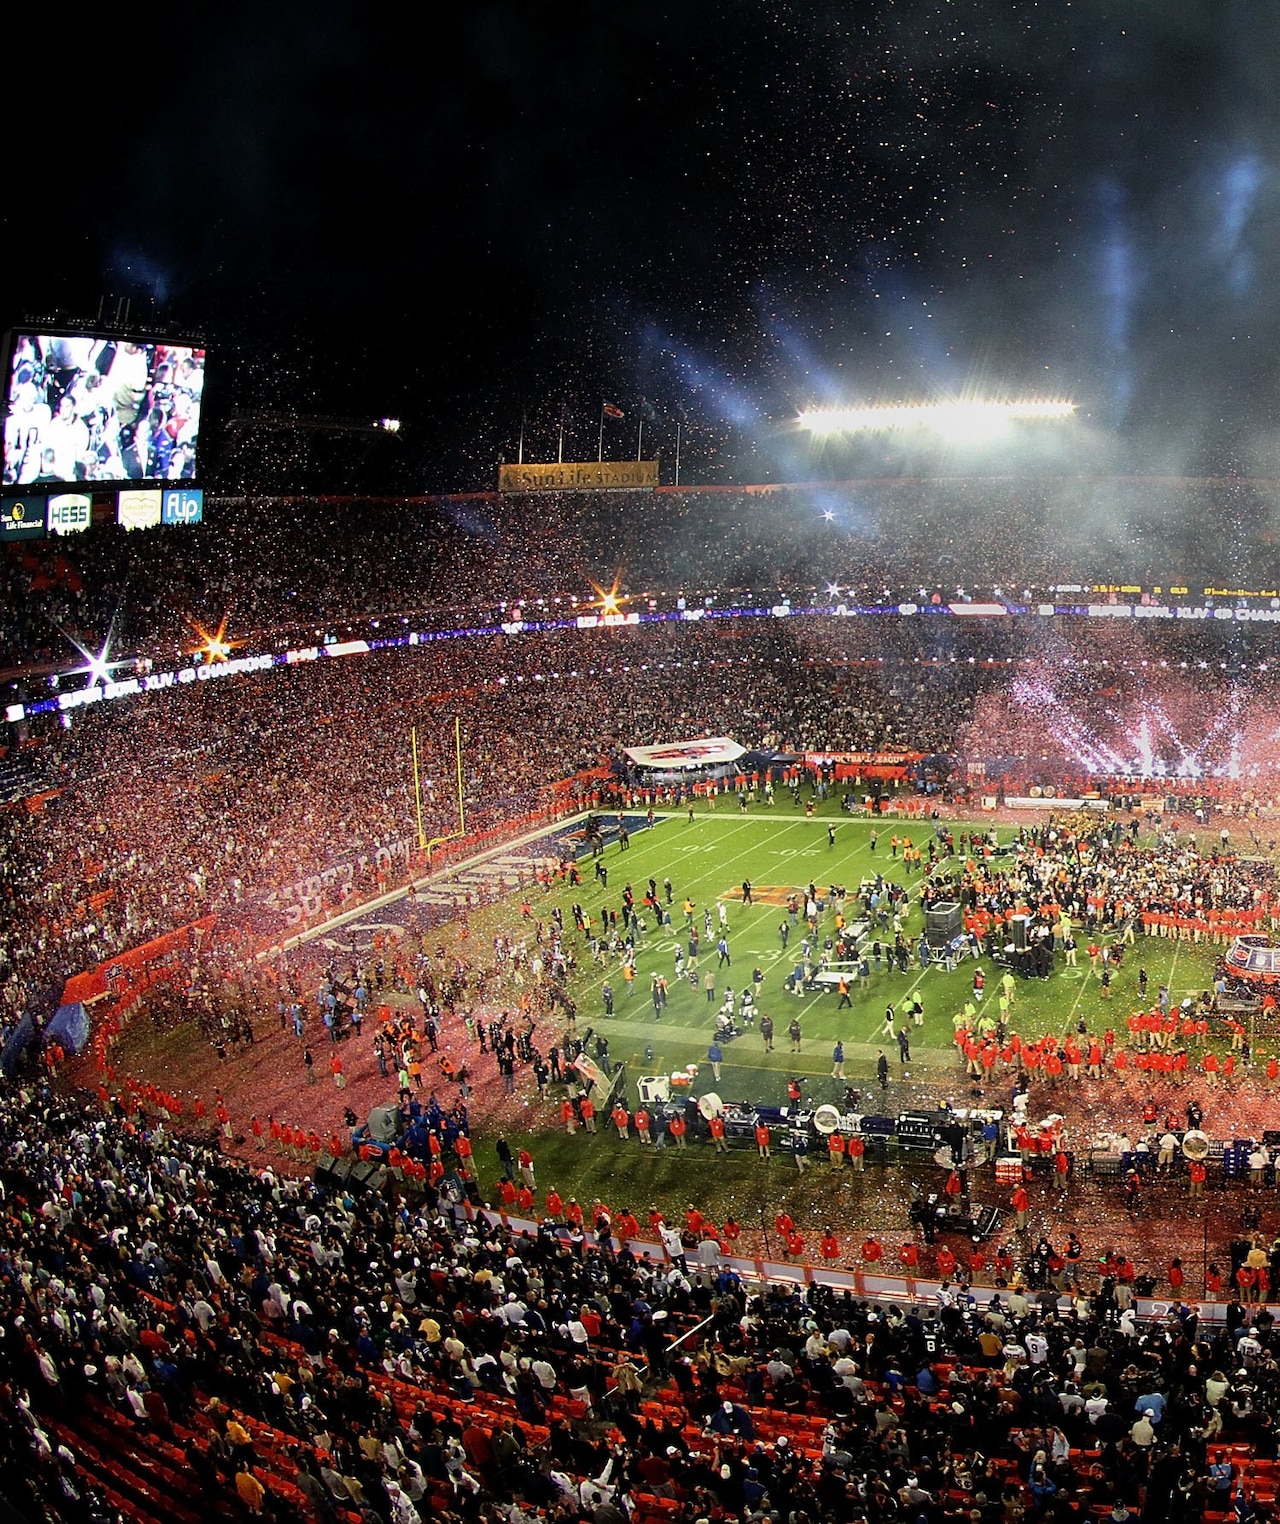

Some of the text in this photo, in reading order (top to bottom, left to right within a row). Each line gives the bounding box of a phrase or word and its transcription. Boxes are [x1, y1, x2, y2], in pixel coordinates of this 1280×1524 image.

[522, 470, 658, 486] Sun Life STADIUM
[51, 506, 87, 524] HESS
[1089, 605, 1132, 617] SUPER
[1135, 606, 1174, 618] BOWL
[1177, 607, 1209, 619] XLIV
[104, 679, 142, 699] BOWL
[145, 672, 174, 691] XLIV
[198, 654, 273, 680] CHAMPIONS
[1059, 966, 1119, 980] 50
[926, 1340, 936, 1352] 8
[1031, 1343, 1038, 1354] 9
